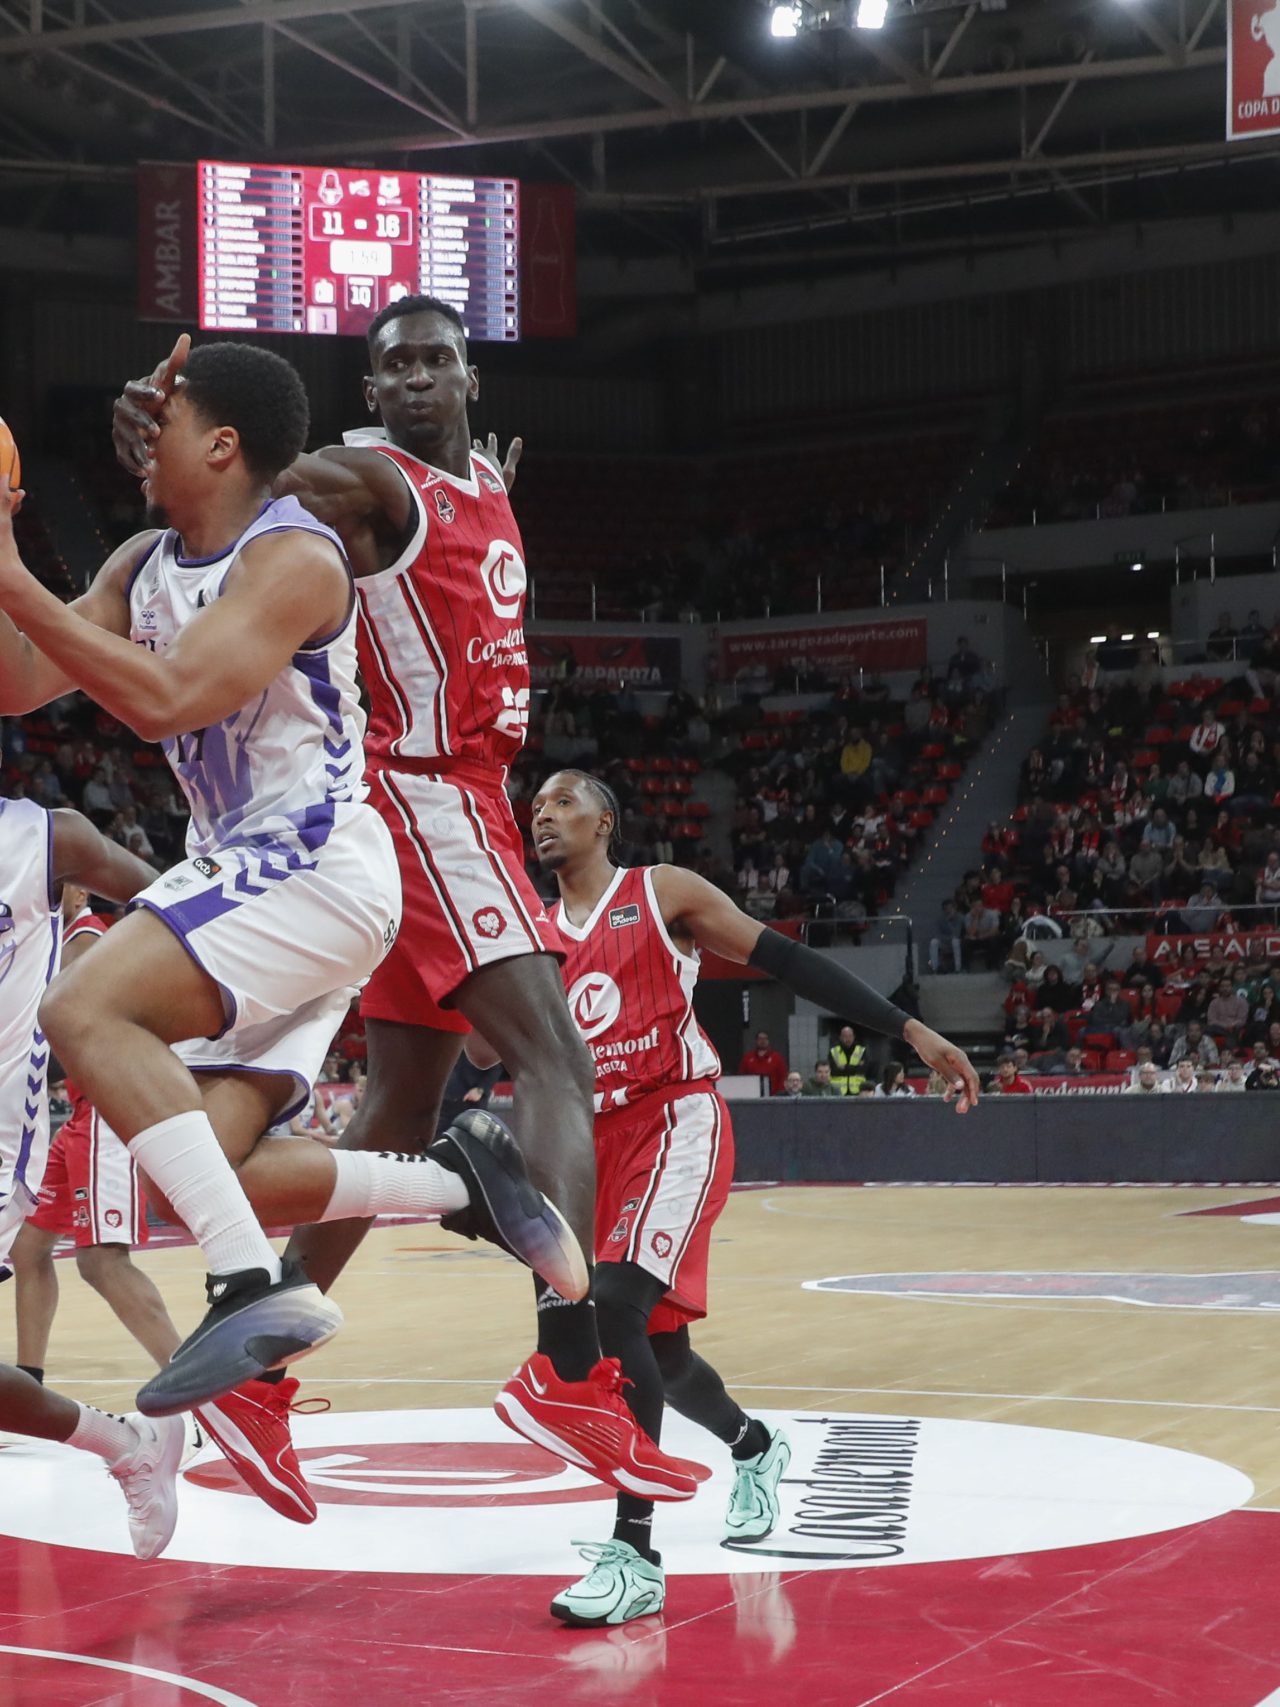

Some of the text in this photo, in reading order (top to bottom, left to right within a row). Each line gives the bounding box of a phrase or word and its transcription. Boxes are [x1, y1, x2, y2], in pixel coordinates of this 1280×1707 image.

[1238, 100, 1269, 119] COPA
[322, 211, 344, 235] 11
[155, 199, 182, 314] AMBAR
[729, 625, 919, 653] www.zaragozadeporte.com
[195, 858, 211, 875] acb
[719, 1417, 923, 1561] Casademont
